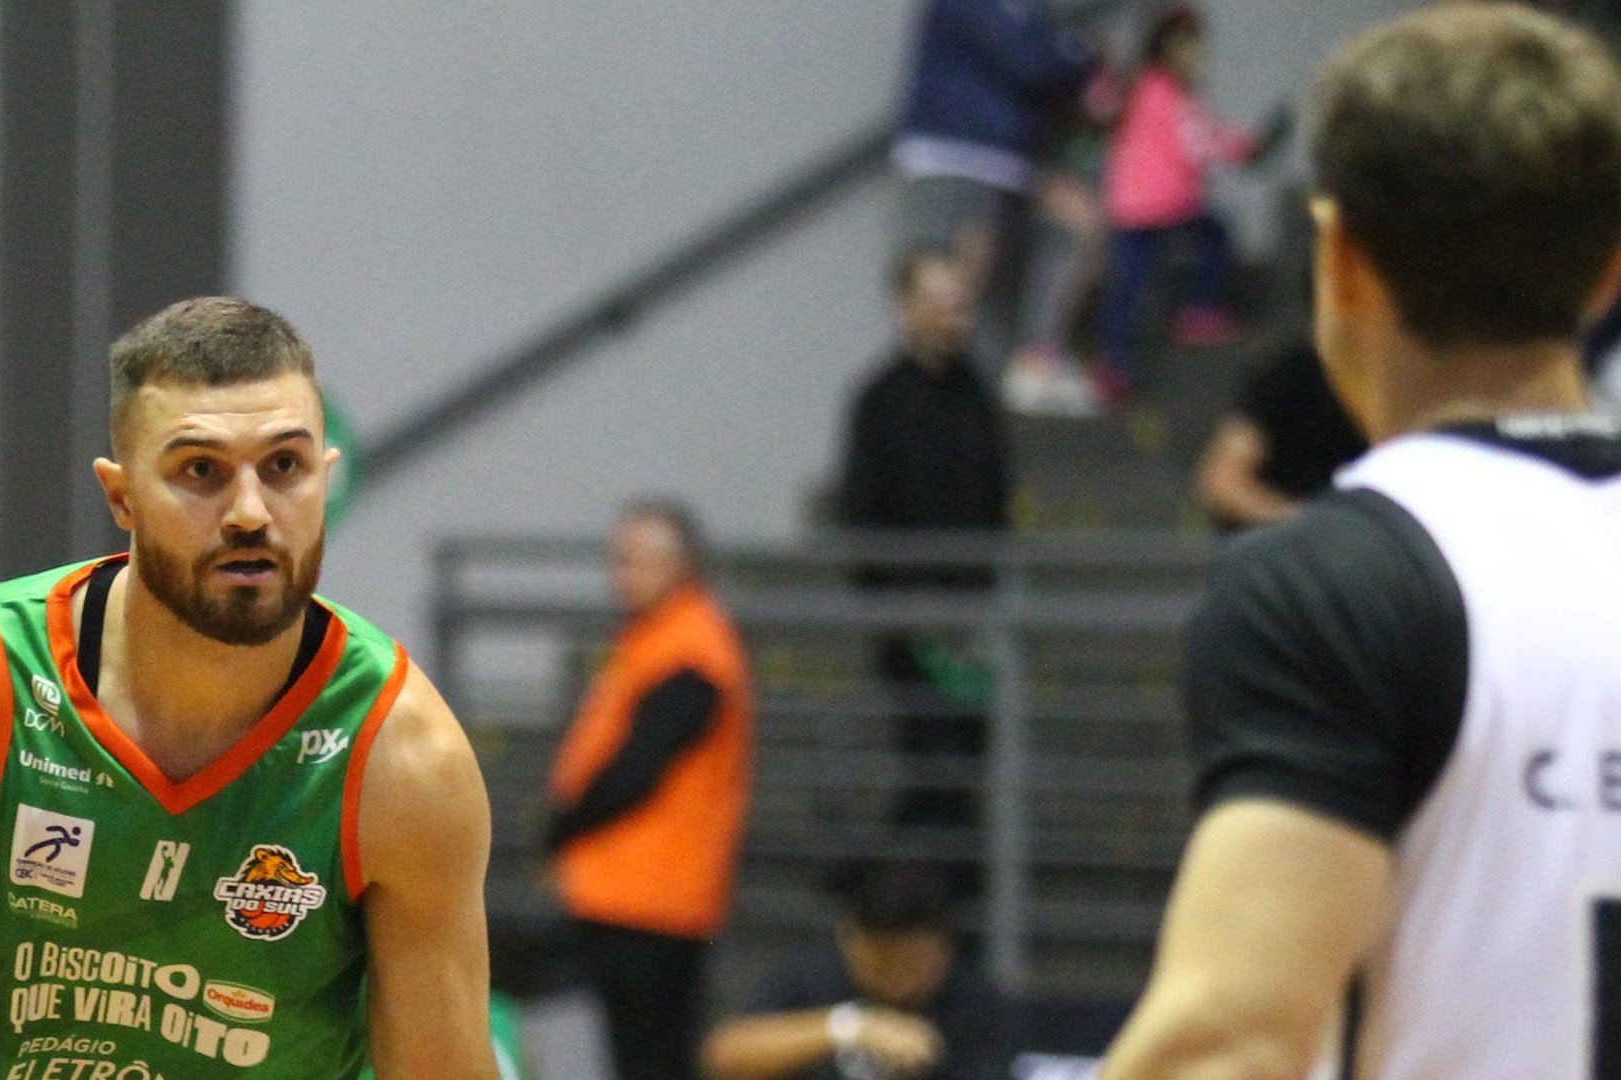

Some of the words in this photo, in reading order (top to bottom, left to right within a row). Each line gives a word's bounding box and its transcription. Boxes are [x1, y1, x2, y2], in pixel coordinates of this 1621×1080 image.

[19, 749, 92, 782] Unimed
[218, 881, 322, 907] CAXIAS
[231, 899, 259, 911] DO
[263, 901, 303, 916] SUL
[14, 942, 34, 981] O
[10, 983, 66, 1033] QUE
[18, 1035, 117, 1058] PEDÁGIO
